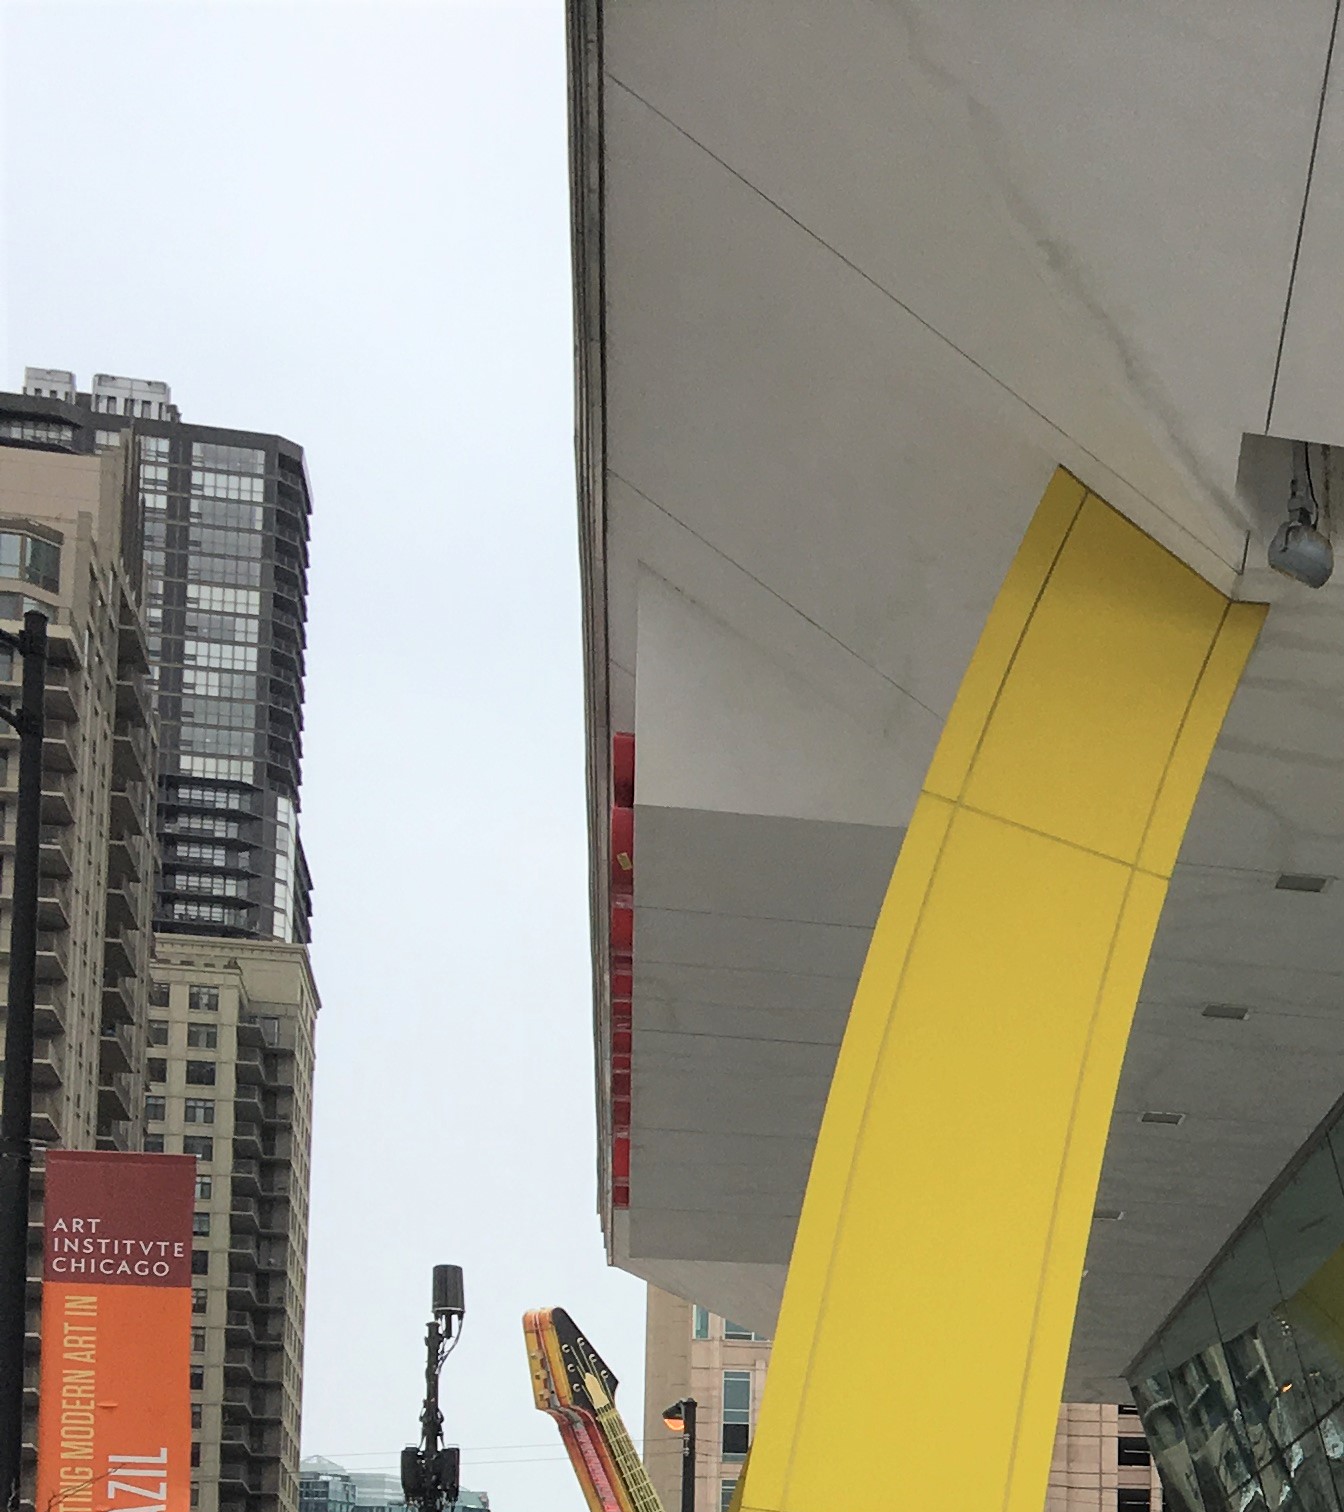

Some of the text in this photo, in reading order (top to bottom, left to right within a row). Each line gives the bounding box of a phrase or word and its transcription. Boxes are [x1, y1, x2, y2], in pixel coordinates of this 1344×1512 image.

[52, 1217, 101, 1233] ART
[52, 1237, 185, 1258] INSTITVTE
[52, 1257, 170, 1277] CHICAGO
[64, 1295, 98, 1317] IN
[62, 1322, 97, 1363] ART
[60, 1369, 95, 1460] MODERN
